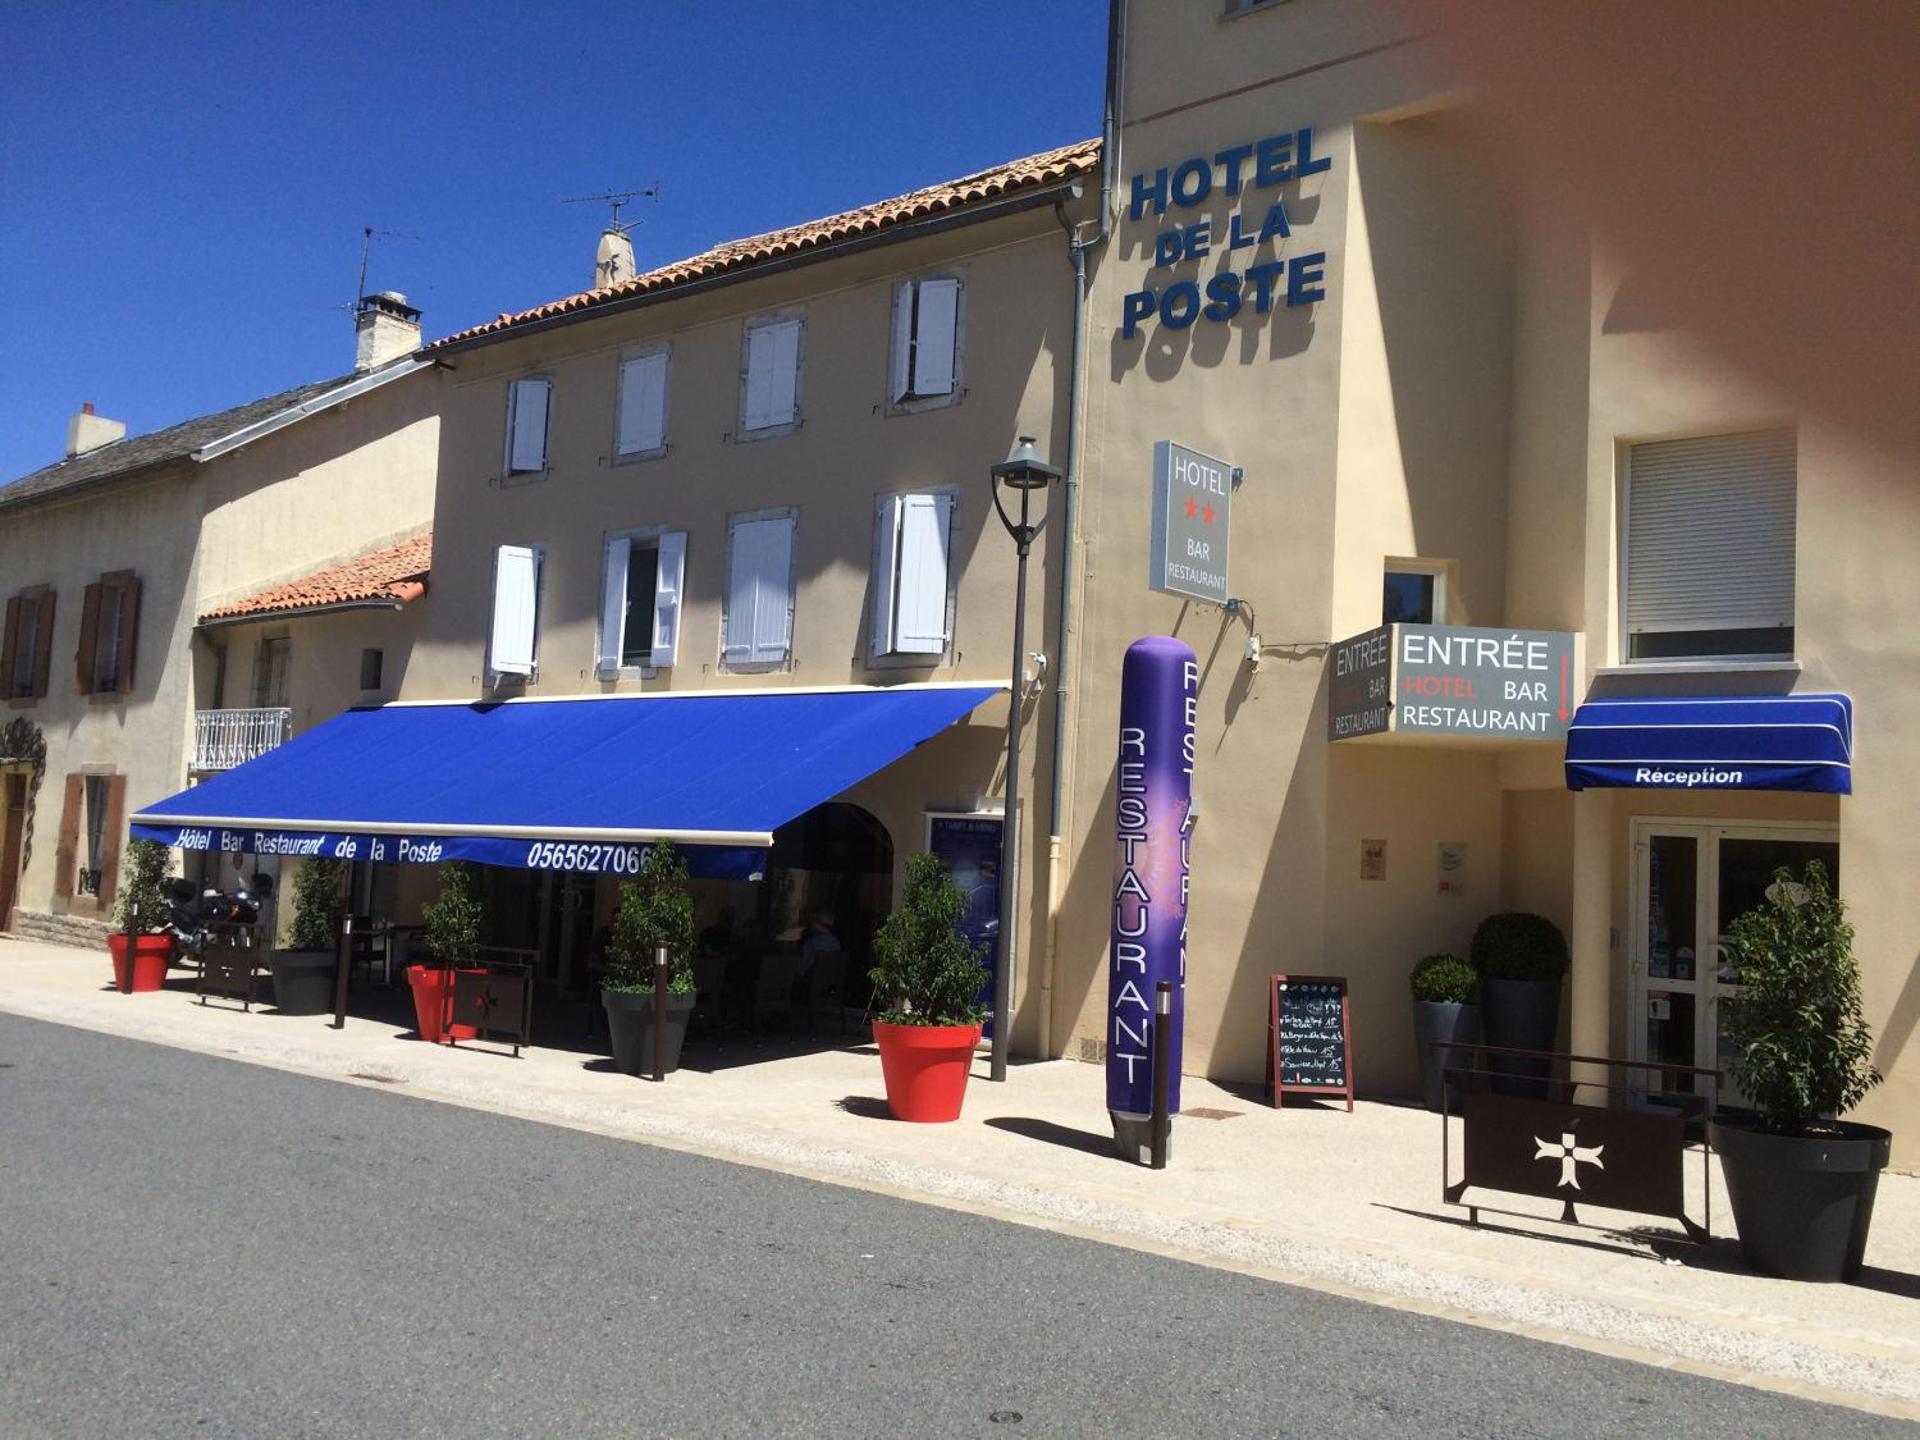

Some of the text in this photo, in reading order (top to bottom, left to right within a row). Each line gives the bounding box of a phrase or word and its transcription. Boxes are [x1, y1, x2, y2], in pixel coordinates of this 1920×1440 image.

[1130, 127, 1332, 221] HOTEL
[1155, 202, 1291, 268] DE LA
[1123, 251, 1326, 340] POSTE
[1175, 455, 1225, 496] HOTEL
[1187, 538, 1210, 561] BAR
[1168, 562, 1225, 591] RESTAURANT
[1336, 631, 1388, 677] ENTRÉE
[1403, 634, 1549, 671] ENTRÉE
[1368, 676, 1386, 699] BAR
[1404, 675, 1548, 702] HOTEL BAR
[1335, 707, 1386, 735] RESTAURANT
[1403, 705, 1550, 732] RESTAURANT
[1635, 767, 1743, 787] Réception
[173, 828, 443, 863] Hôtel Bar Restaurant de la Poste
[1114, 727, 1150, 1084] RESTAURANT
